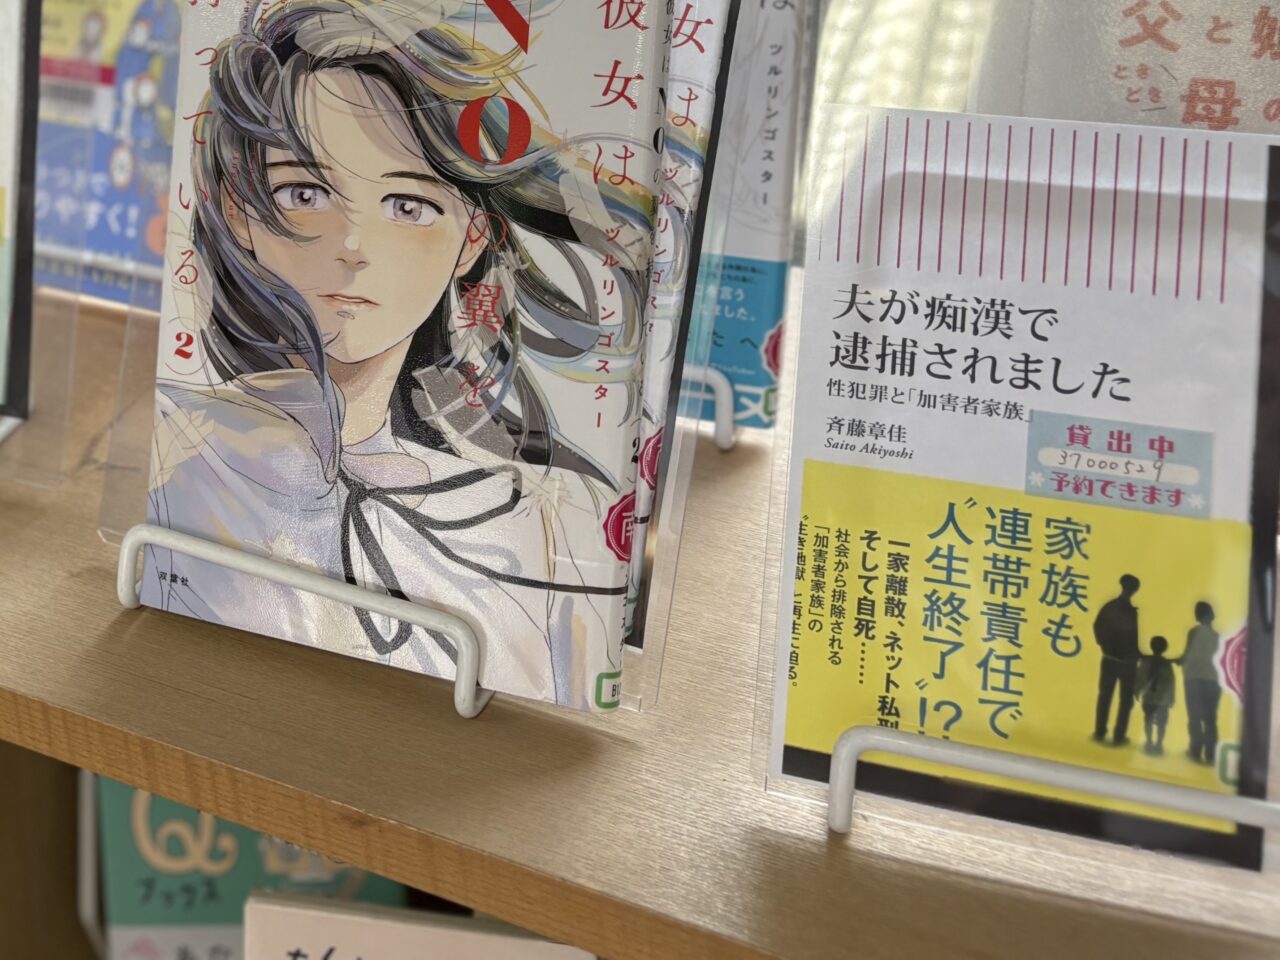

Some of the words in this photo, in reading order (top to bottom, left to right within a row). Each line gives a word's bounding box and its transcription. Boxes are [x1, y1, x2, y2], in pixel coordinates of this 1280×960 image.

[761, 42, 783, 204] ツルリンゴスター
[593, 224, 622, 429] ツルリンゴスター
[832, 283, 1059, 343] 夫が痴漢で
[826, 378, 1033, 423] 性犯罪と「加害者家族」
[829, 330, 1132, 403] 逮捕されました
[824, 437, 857, 453] Saito
[859, 441, 914, 460] Akiyoshi
[825, 416, 908, 444] 斉藤章佳
[1066, 423, 1176, 457] 貸出中
[1049, 472, 1186, 508] 予約できます
[807, 524, 830, 633] 「加害者家族」の
[827, 527, 851, 666] 社会から排除される
[1038, 517, 1091, 658] 家族も
[976, 507, 1033, 740] 連帯責任で
